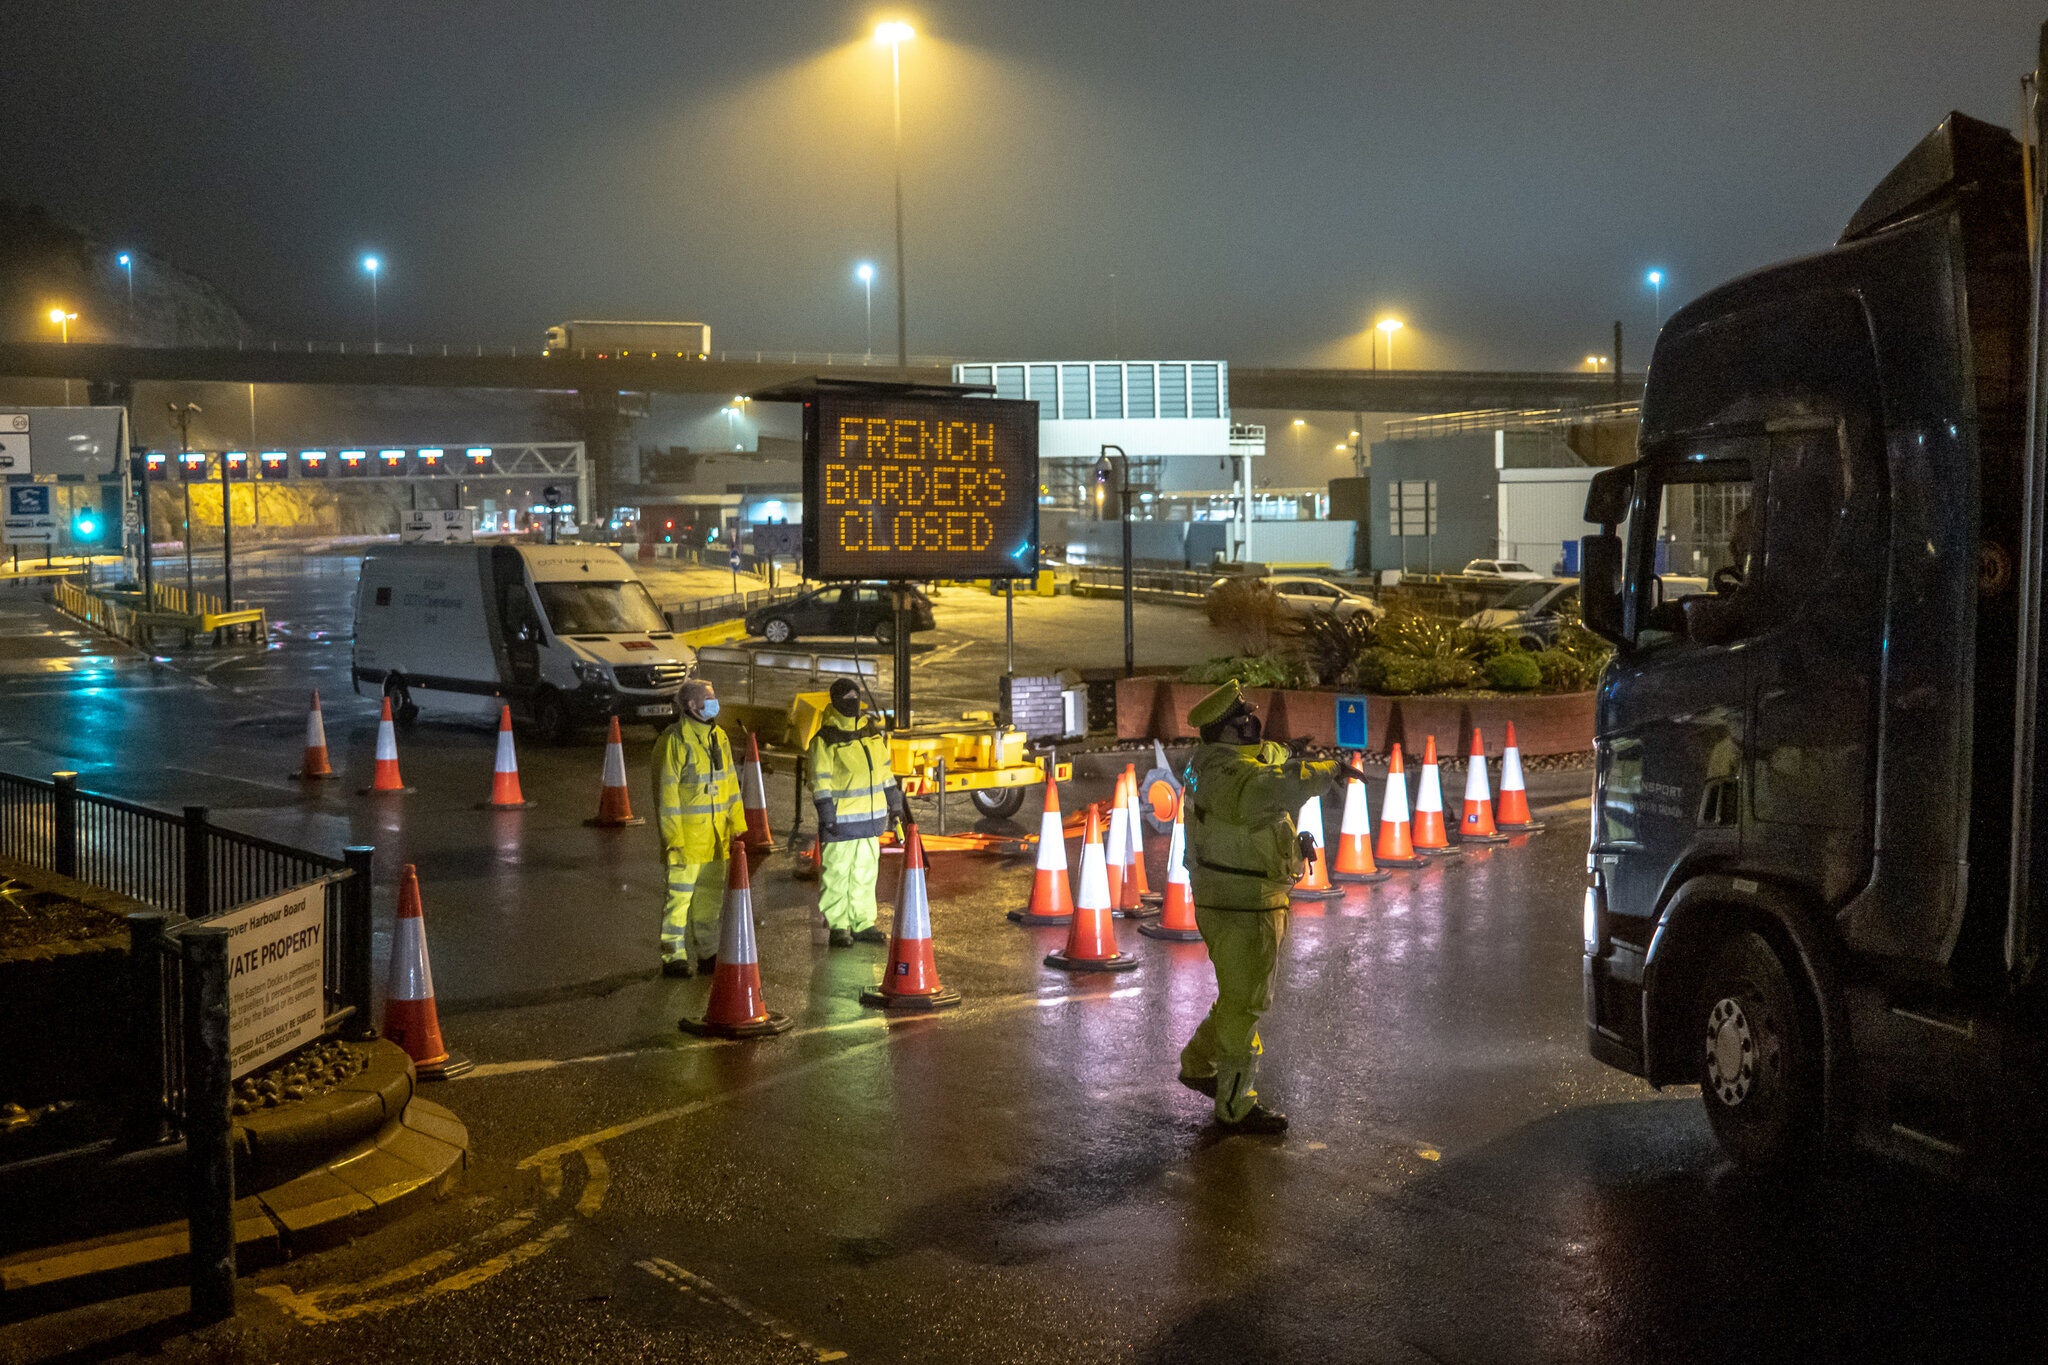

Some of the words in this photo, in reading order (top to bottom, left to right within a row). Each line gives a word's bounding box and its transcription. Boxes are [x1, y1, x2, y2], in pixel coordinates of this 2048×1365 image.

[840, 417, 994, 461] FRENCH
[826, 464, 1006, 507] BORDERS
[840, 510, 993, 551] CLOSED
[228, 922, 248, 938] over
[249, 909, 282, 931] Harbour
[283, 897, 306, 918] Board
[228, 948, 259, 980] VATE
[261, 923, 321, 966] PROPERTY
[245, 983, 266, 999] Eastern
[267, 973, 283, 989] Docks
[244, 1016, 251, 1028] by
[252, 1010, 262, 1022] the
[263, 1002, 279, 1018] Board
[255, 1028, 275, 1045] ACCESS
[275, 1022, 288, 1036] MAY
[289, 1018, 296, 1029] BE
[297, 1008, 317, 1026] SUBJECT
[238, 1045, 266, 1065] CRIMINAL
[266, 1027, 301, 1050] PROSECUTION
